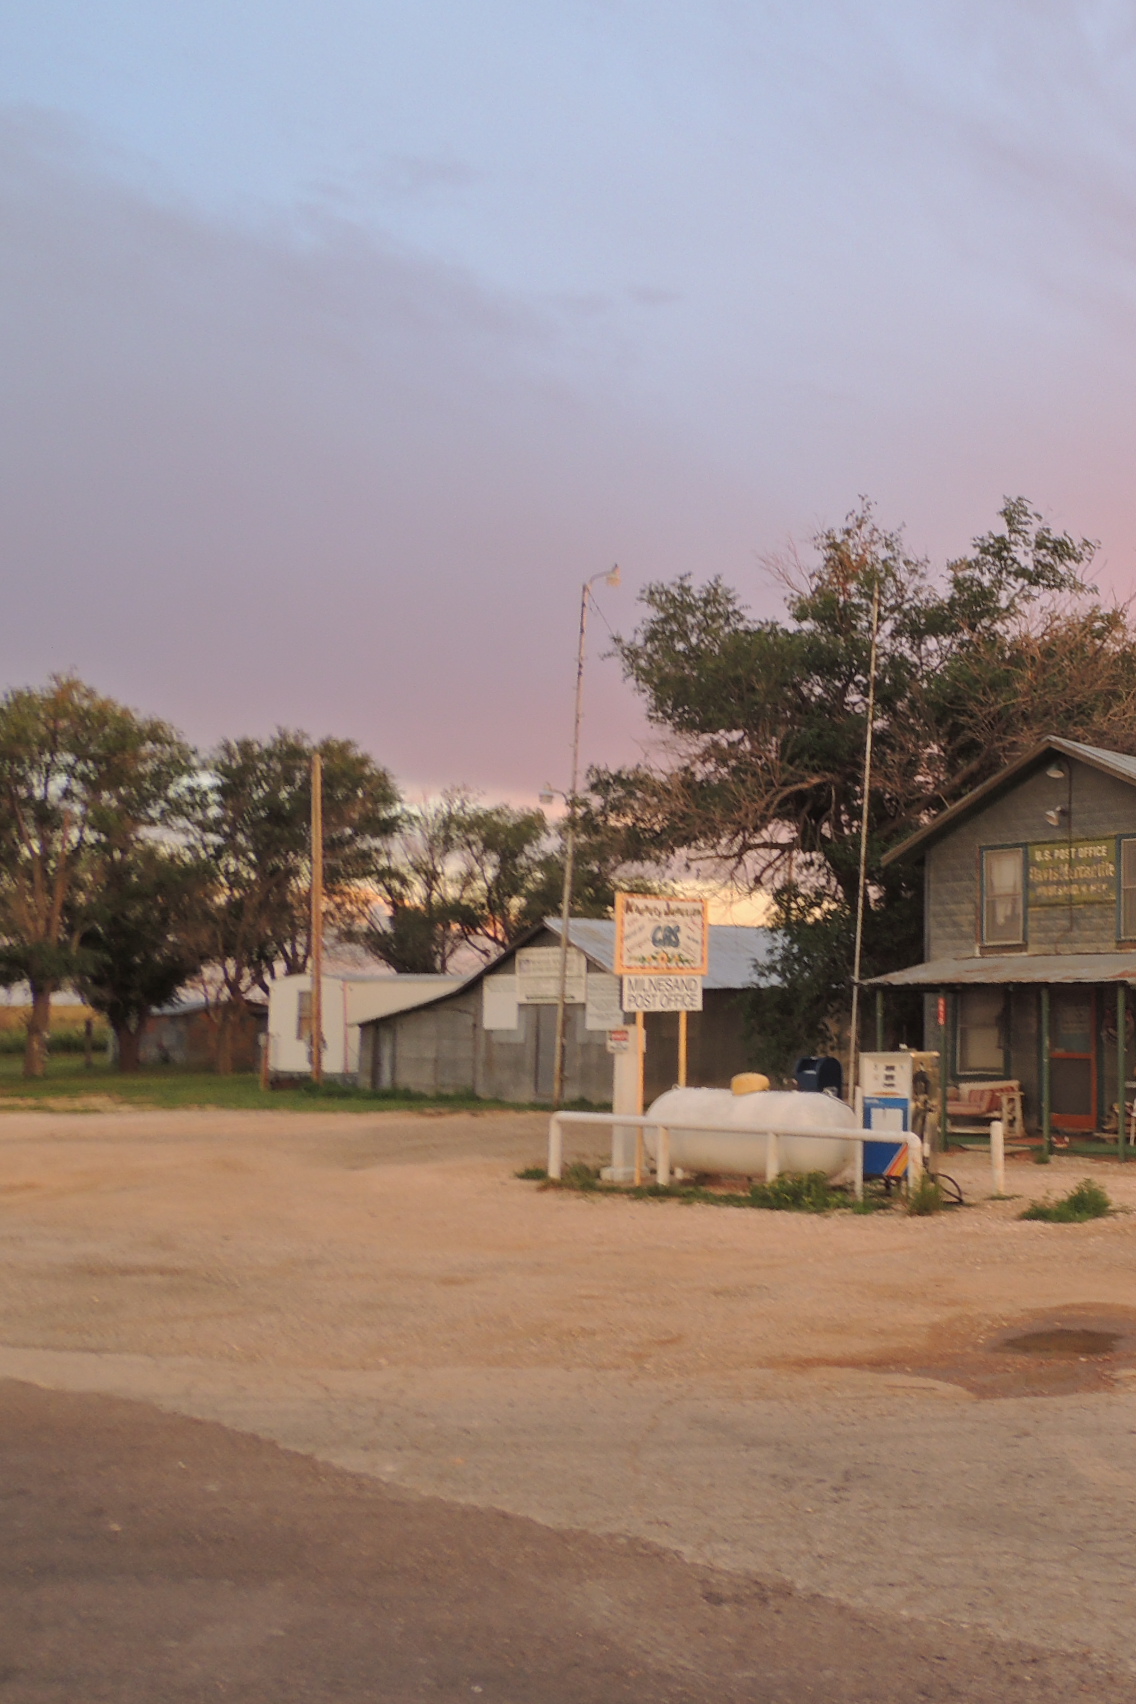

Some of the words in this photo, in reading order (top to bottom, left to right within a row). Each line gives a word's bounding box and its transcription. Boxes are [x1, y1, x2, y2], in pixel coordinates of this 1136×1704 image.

[1054, 847, 1076, 860] POST
[1078, 845, 1108, 859] OFFICE
[651, 924, 681, 948] GAS
[627, 976, 698, 992] MILNESAND
[627, 993, 657, 1008] POST
[659, 993, 698, 1008] OFFICE
